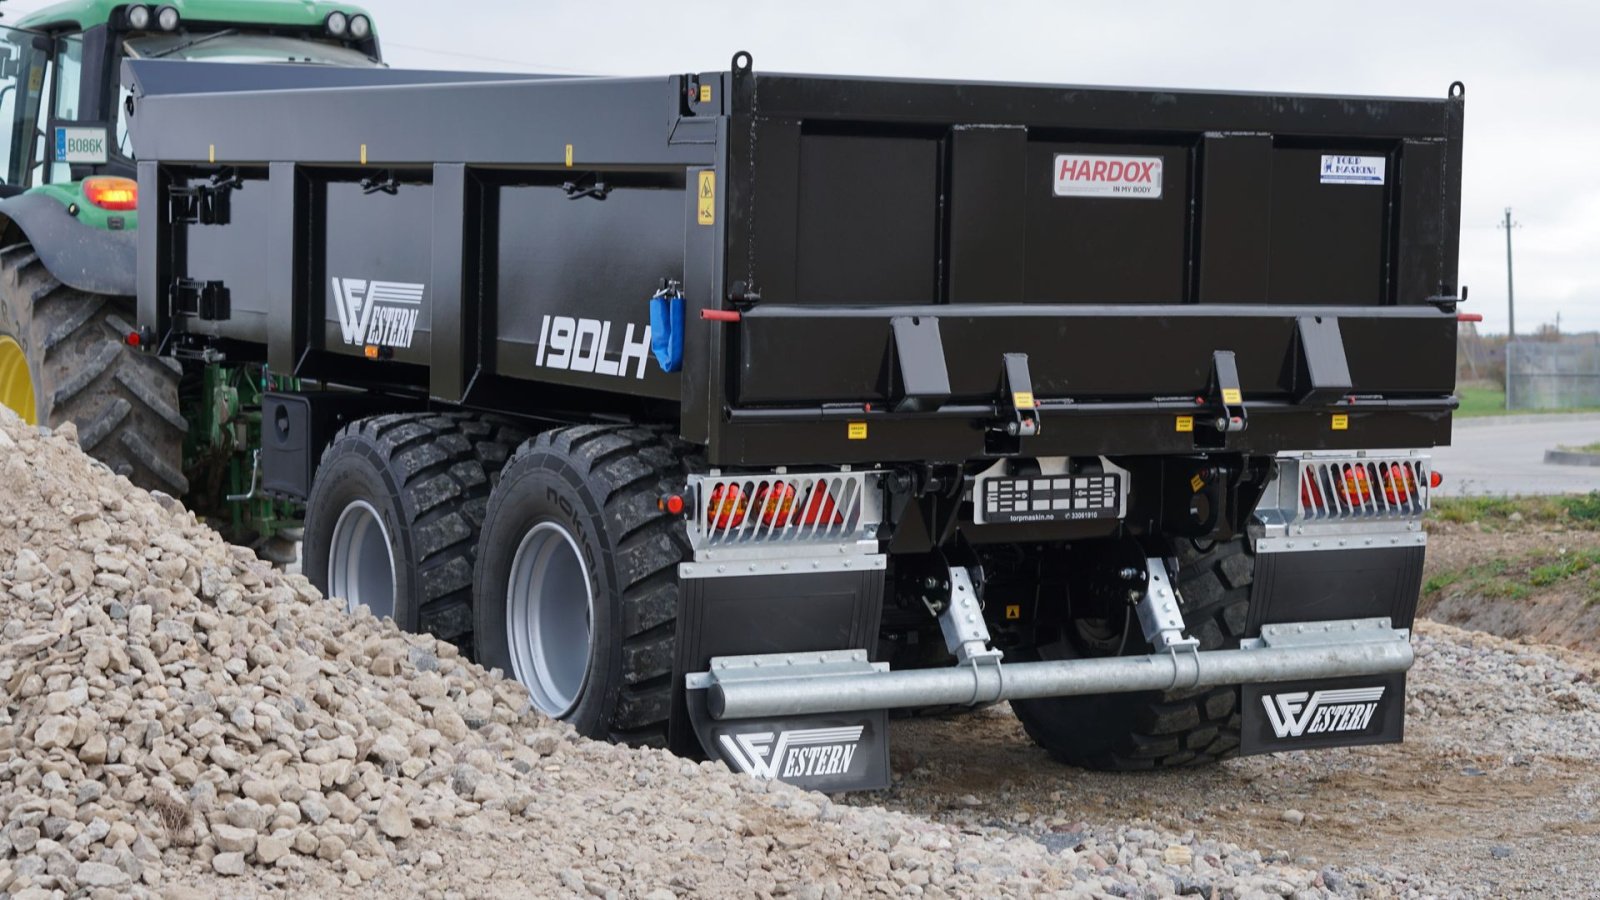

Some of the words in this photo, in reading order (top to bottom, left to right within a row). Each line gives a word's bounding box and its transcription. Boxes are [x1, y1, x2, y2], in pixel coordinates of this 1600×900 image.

[68, 138, 103, 153] B086K
[1059, 160, 1154, 183] HARDOX
[1009, 513, 1055, 523] torpmaskin.no
